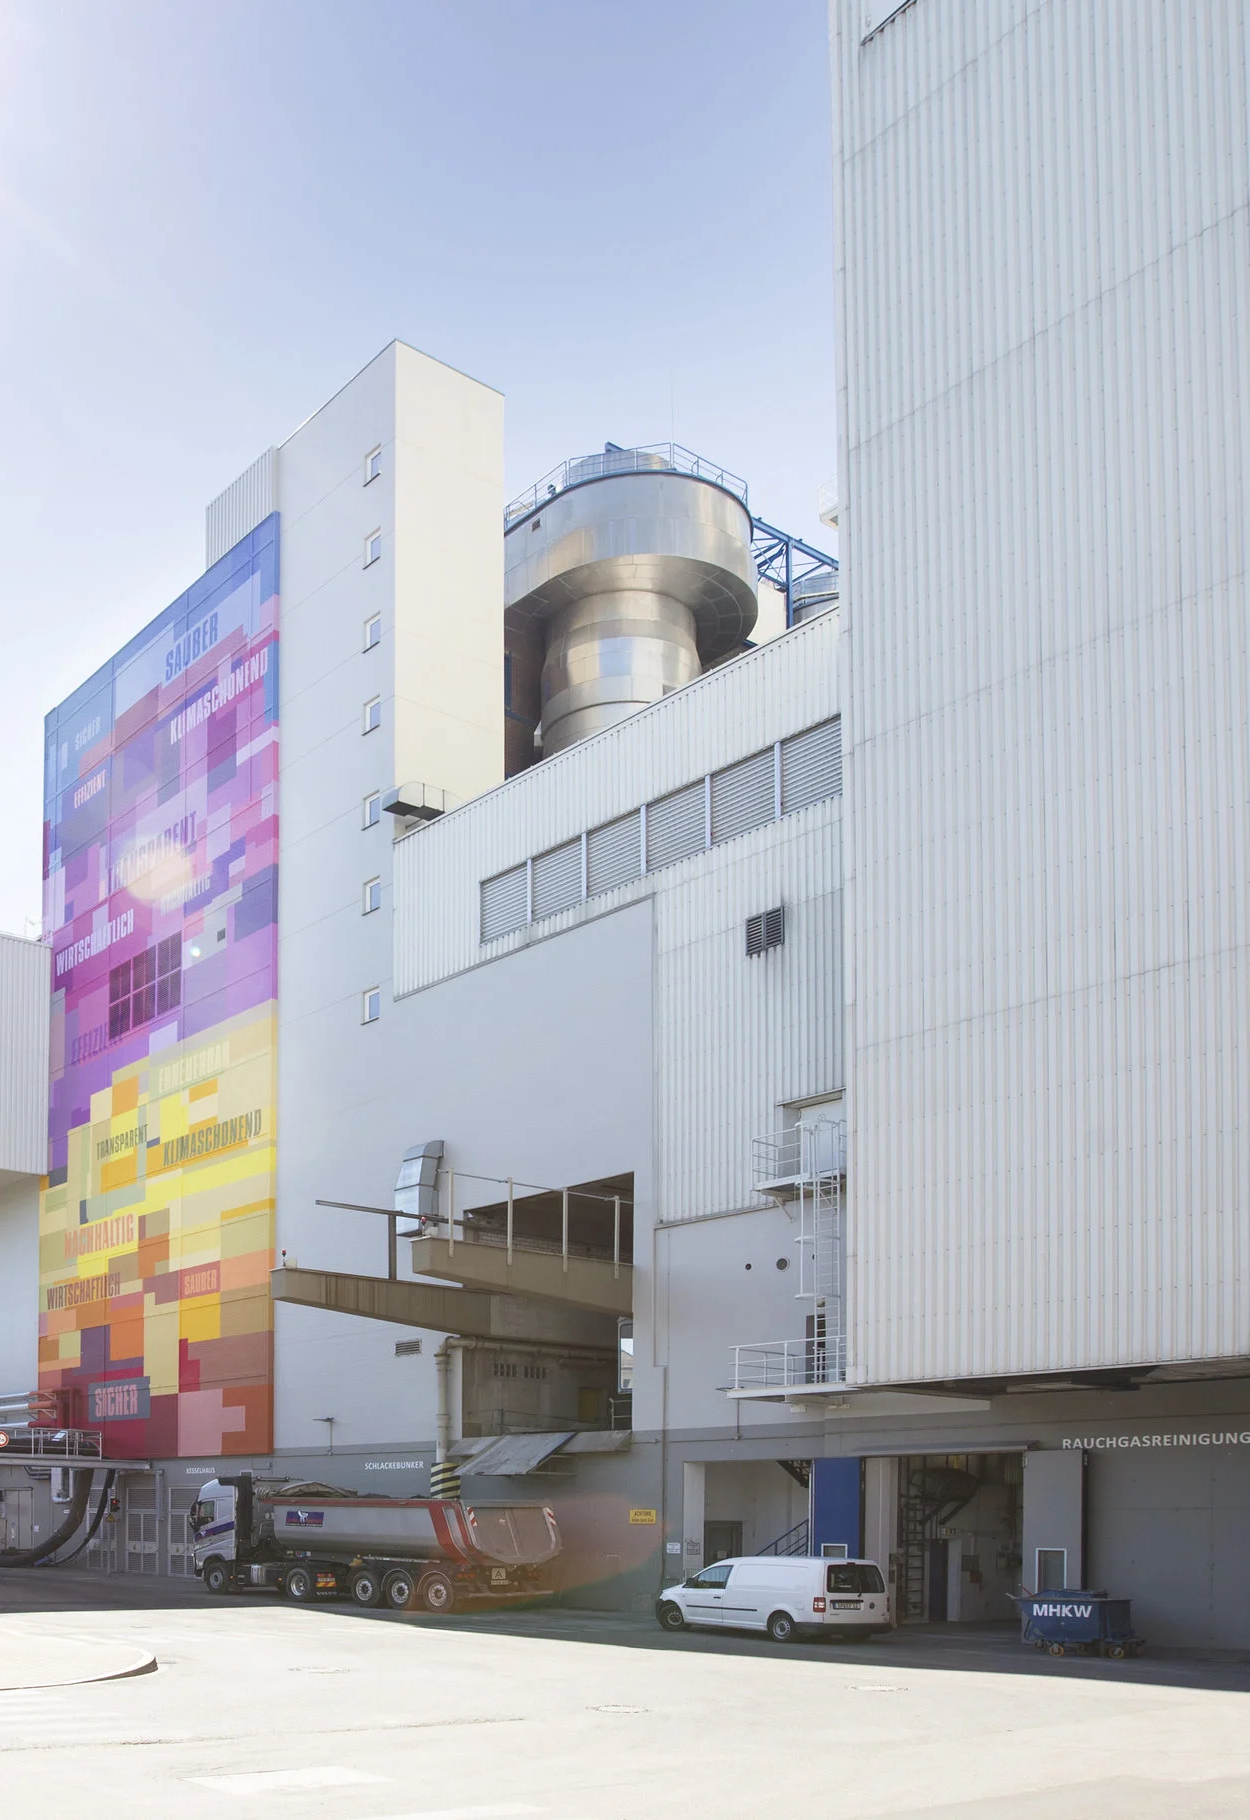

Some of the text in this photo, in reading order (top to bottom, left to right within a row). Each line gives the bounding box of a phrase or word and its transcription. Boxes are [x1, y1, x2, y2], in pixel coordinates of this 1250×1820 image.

[165, 611, 219, 682] SAUBER
[170, 647, 268, 745] KLIMASCHONEND
[74, 769, 107, 809] EFFIZIENT
[56, 908, 134, 977] WIRTSCHAFTLICH
[96, 1123, 148, 1161] TRANSPARENT
[163, 1108, 262, 1167] KLIMASCHONEND
[64, 1212, 134, 1263] NACHHALTIG
[47, 1271, 121, 1310] WIRTSCHAFTLICH
[184, 1268, 218, 1296] SAUBER
[94, 1383, 139, 1418] SICHER
[1062, 1431, 1250, 1450] RAUCHGASREINIGUNG
[186, 1466, 216, 1474] KESSELHAUS
[364, 1460, 424, 1470] SCHLACKEBUNKER
[1032, 1603, 1093, 1618] MHKW
